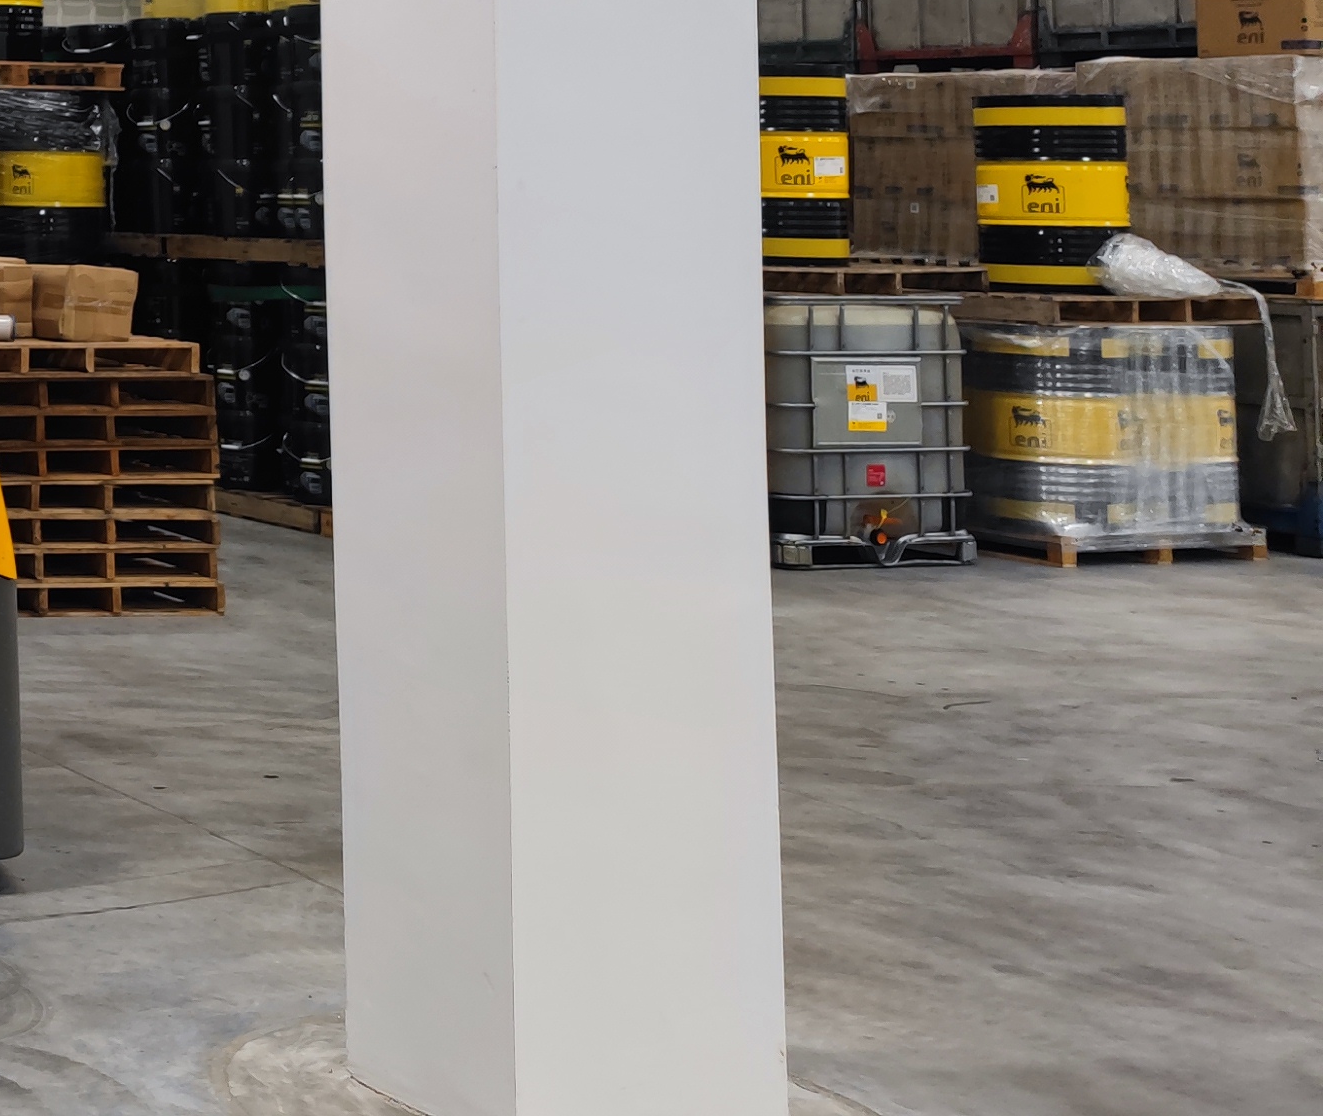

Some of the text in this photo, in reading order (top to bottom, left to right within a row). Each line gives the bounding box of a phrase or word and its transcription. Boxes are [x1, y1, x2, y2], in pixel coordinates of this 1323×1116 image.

[1237, 27, 1265, 44] eni
[780, 168, 812, 185] eni
[12, 182, 32, 195] eni
[1028, 197, 1060, 213] eni
[855, 391, 871, 402] eni
